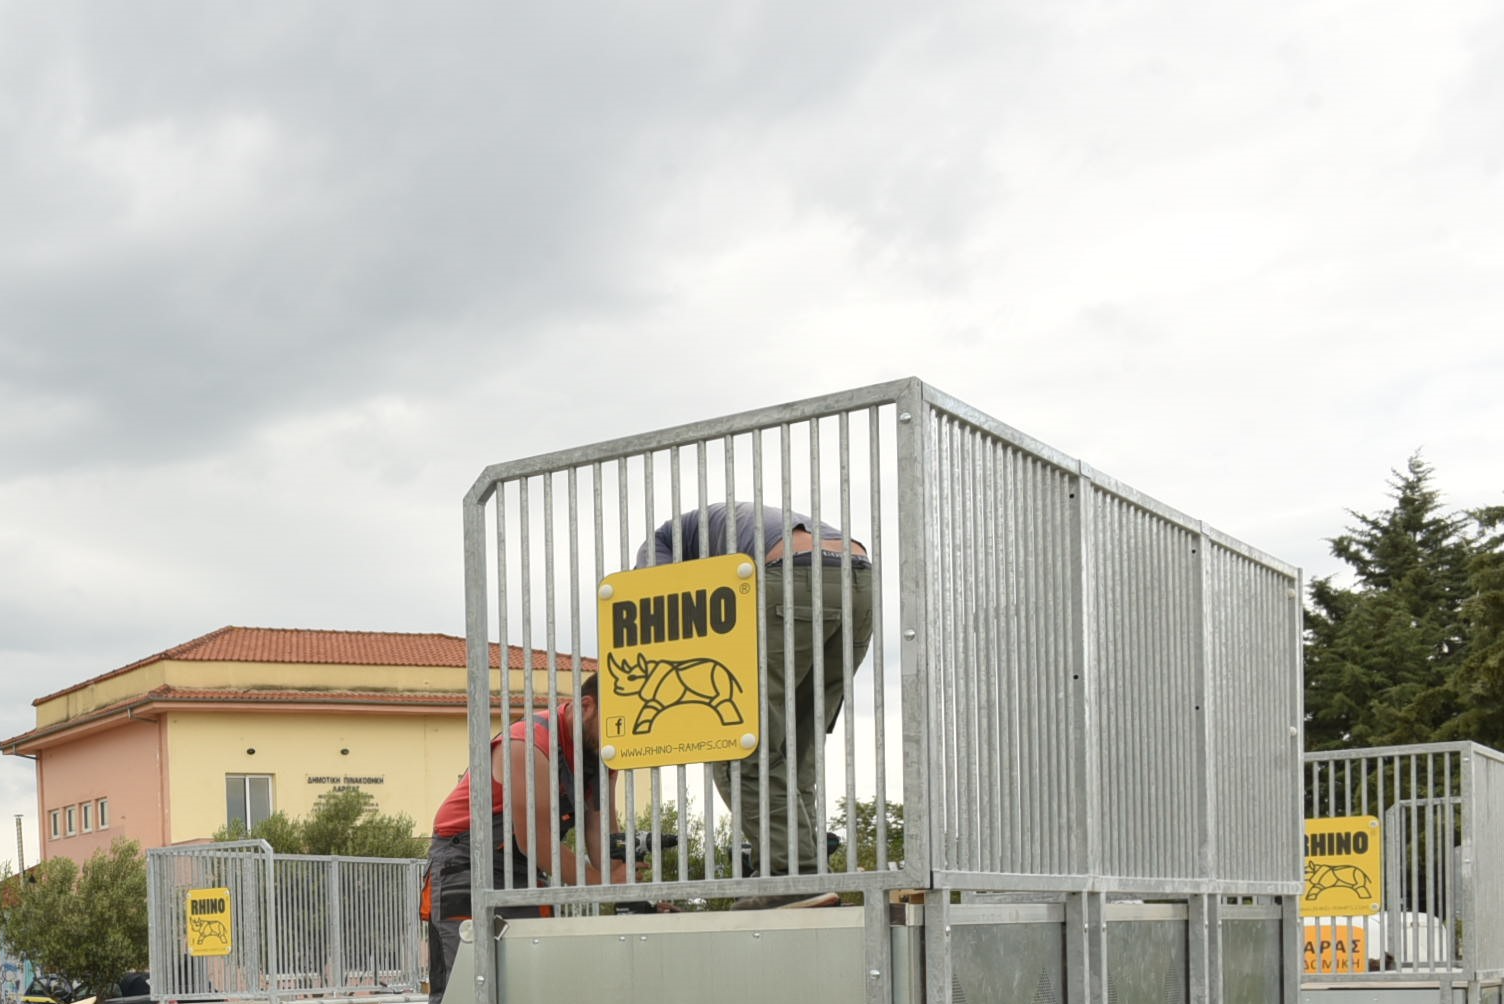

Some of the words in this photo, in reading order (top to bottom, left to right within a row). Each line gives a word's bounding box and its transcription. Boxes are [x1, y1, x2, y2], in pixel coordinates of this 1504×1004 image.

[612, 586, 736, 649] RHINO
[620, 738, 737, 758] WWW.RHINO-RAMPS.COM
[191, 897, 226, 916] RHINO
